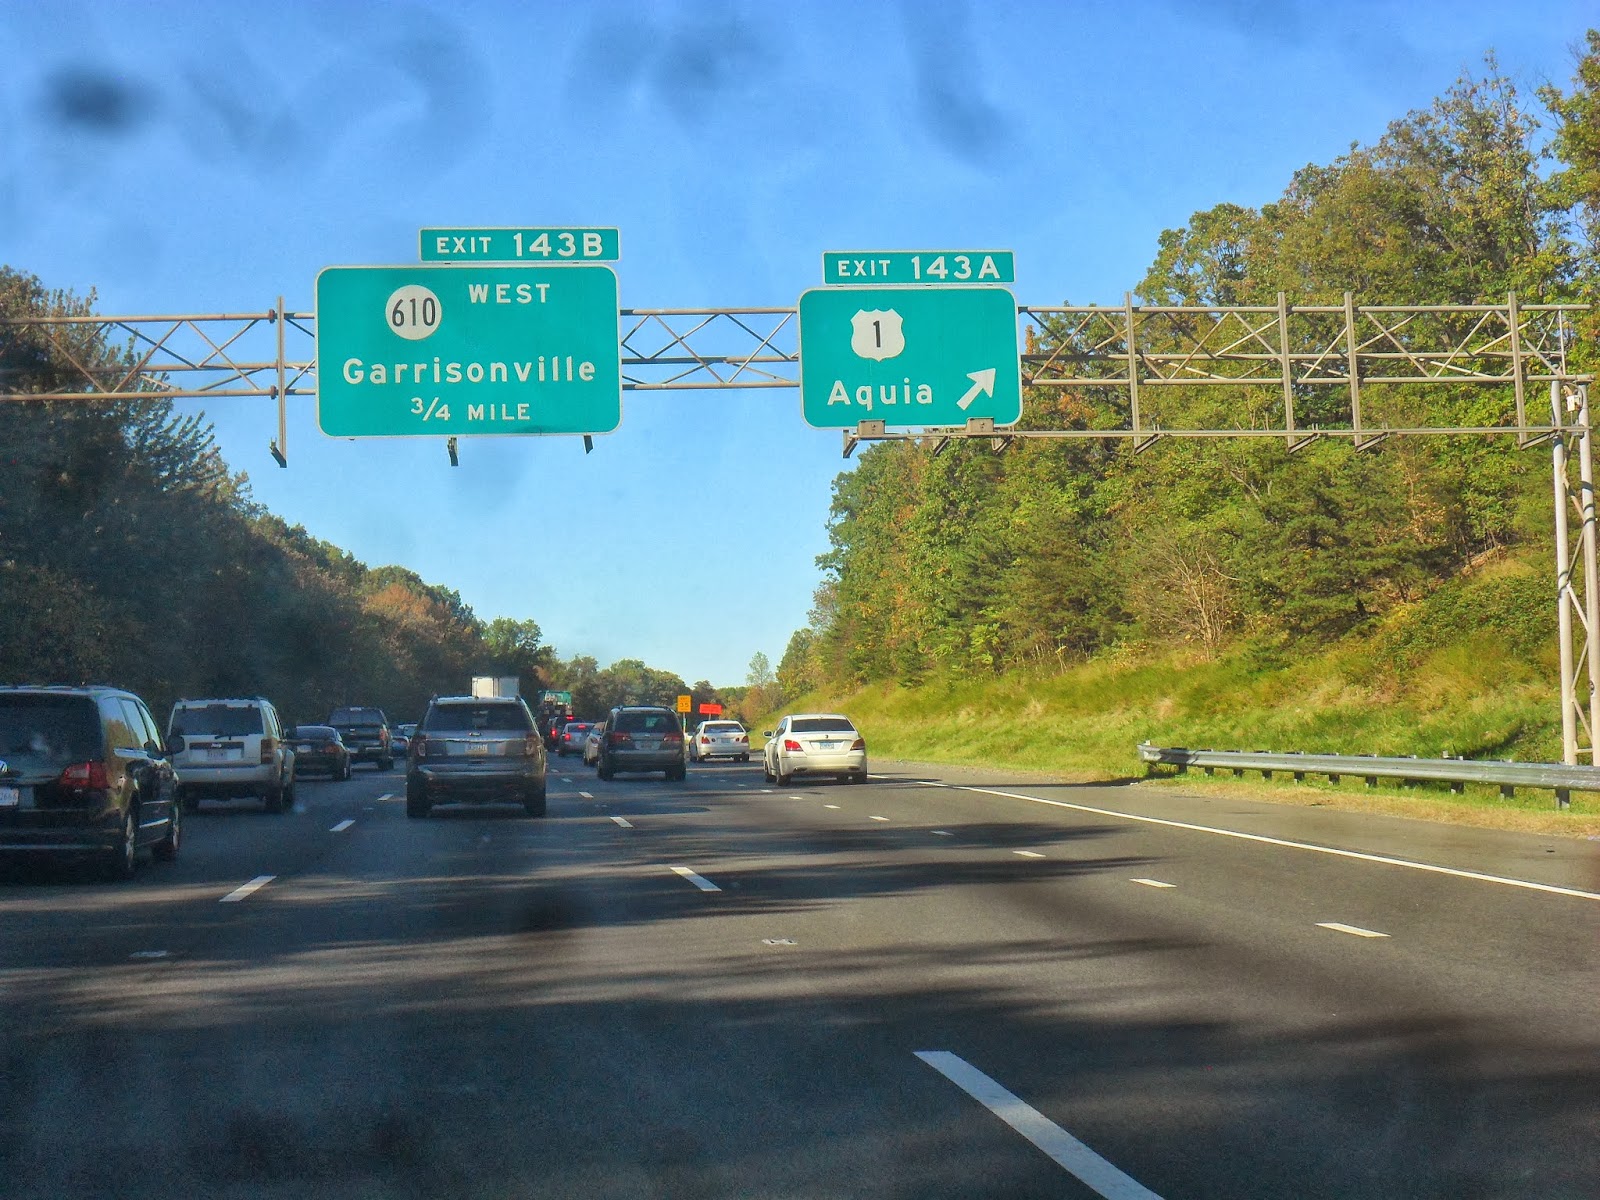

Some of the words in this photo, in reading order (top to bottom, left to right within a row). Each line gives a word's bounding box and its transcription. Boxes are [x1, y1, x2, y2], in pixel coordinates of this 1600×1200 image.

[436, 237, 492, 254] EXIT
[513, 233, 603, 257] 143B
[837, 260, 891, 277] EXIT
[911, 255, 1001, 280] 143A
[468, 283, 551, 304] WEST
[391, 297, 436, 327] 610
[872, 320, 881, 348] 1
[343, 355, 596, 385] Garrisonville
[827, 377, 933, 411] Aquia
[410, 397, 451, 422] 3/4
[468, 403, 531, 421] MILE
